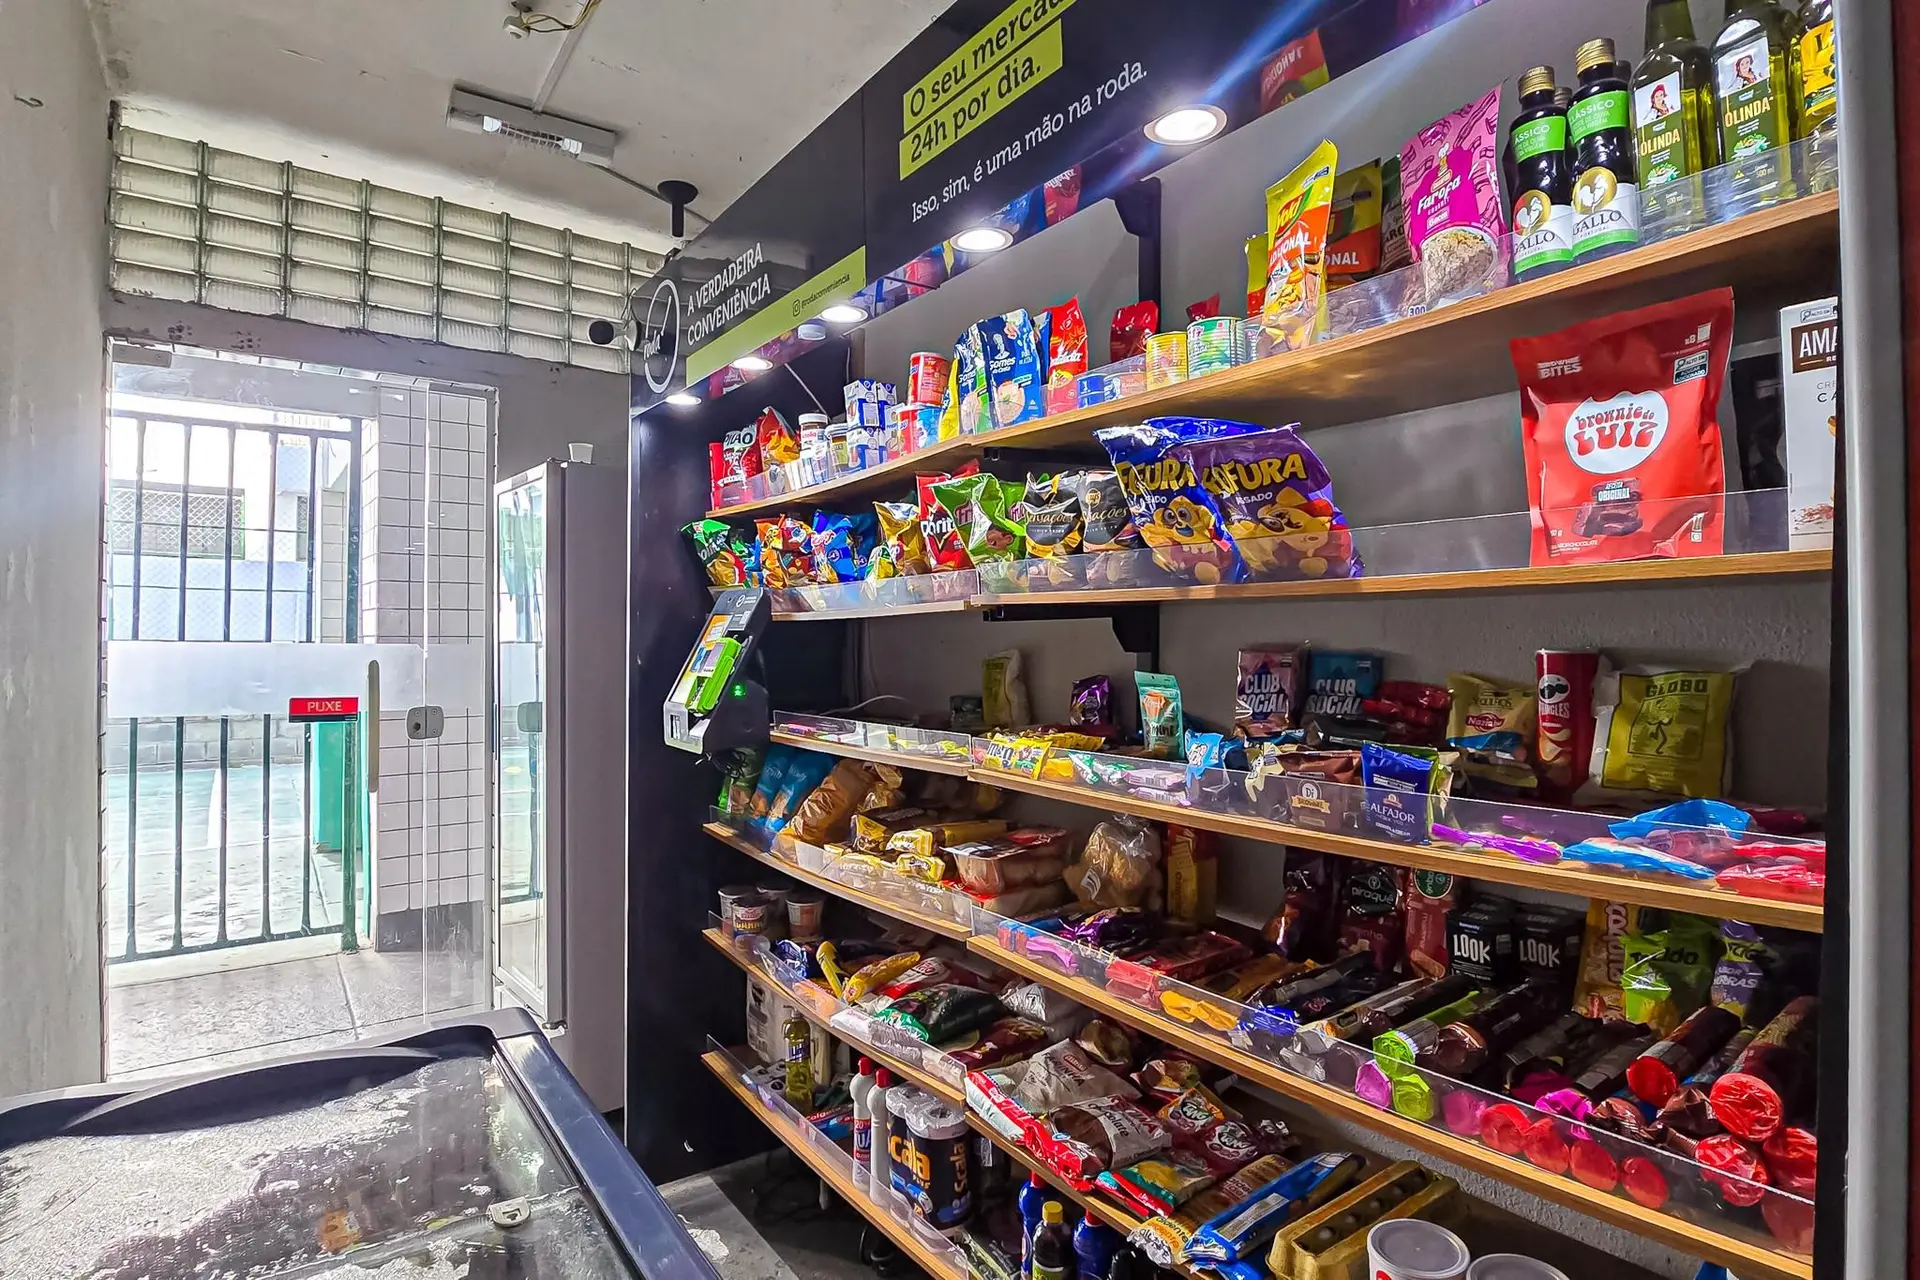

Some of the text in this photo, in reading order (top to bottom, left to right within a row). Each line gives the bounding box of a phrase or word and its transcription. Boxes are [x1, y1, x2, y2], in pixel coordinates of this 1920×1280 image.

[910, 87, 925, 117] O
[931, 61, 967, 103] seu
[911, 56, 1042, 163] 24h por dia.
[1724, 98, 1772, 128] OLINDA
[912, 60, 1148, 223] Isso, sim, é uma mão na roda.
[1640, 128, 1680, 157] OLINDA
[1416, 175, 1461, 215] Farofa
[1573, 210, 1622, 236] GALLO
[687, 241, 764, 316] A VERDADEIRA
[687, 273, 771, 346] CONVENIÊNCIA
[989, 357, 1016, 371] Gomes
[1539, 363, 1583, 380] BITES
[1575, 402, 1655, 430] brownie do
[1573, 420, 1659, 457] LUIZ
[1245, 674, 1281, 694] CLUB
[1315, 678, 1357, 696] CLUB
[1645, 678, 1709, 698] GLOBO
[307, 700, 343, 713] PUXE
[1239, 694, 1287, 713] SOCIAL
[1305, 697, 1363, 715] SOCIAL
[1305, 787, 1315, 799] Di
[1370, 802, 1416, 824] ALFAJOR
[1352, 886, 1395, 905] piraquê
[1453, 933, 1492, 964] LOOK
[1520, 937, 1560, 968] LOOK
[888, 1136, 931, 1181] cala
[950, 1142, 968, 1192] Scala
